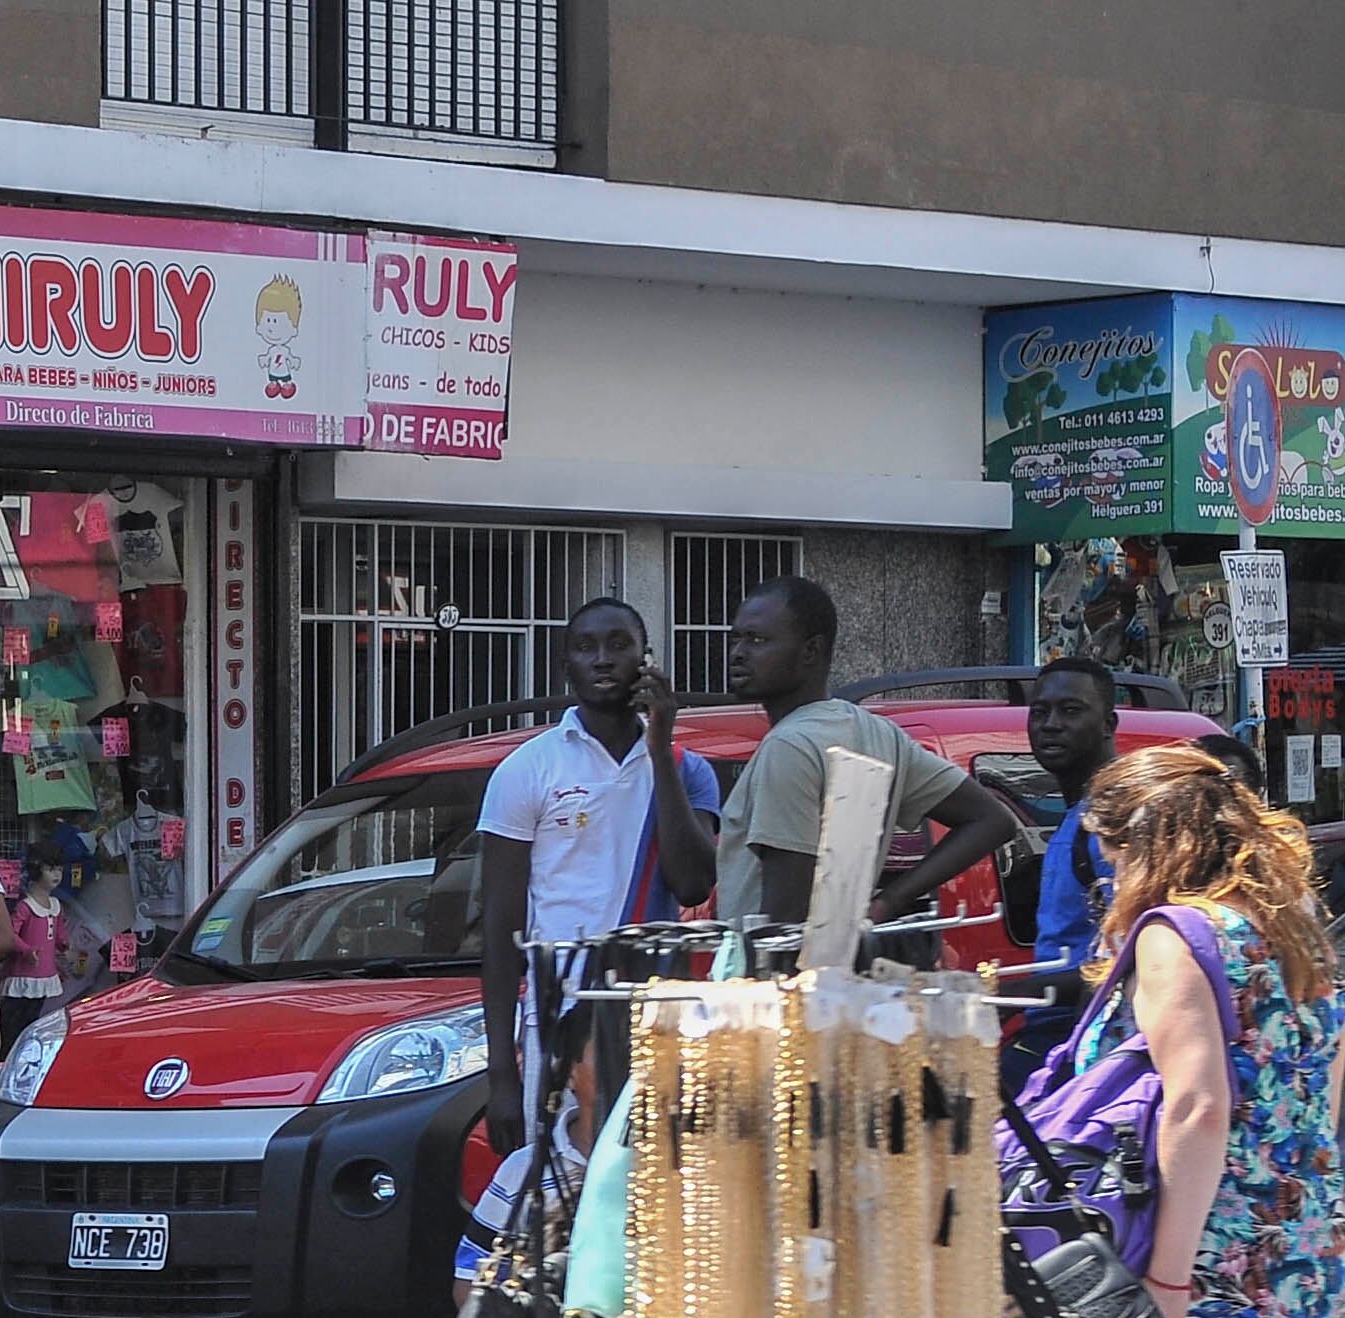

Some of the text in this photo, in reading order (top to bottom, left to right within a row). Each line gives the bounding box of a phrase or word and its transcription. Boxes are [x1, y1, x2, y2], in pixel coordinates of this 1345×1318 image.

[372, 253, 517, 323] RULY
[381, 326, 445, 349] CHICOS
[468, 332, 510, 354] KIDS
[999, 326, 1164, 381] Conejitos
[28, 366, 77, 387] BEBES
[93, 367, 137, 391] NIÑOS
[153, 375, 216, 396] JUNIORS
[366, 367, 409, 394] jeans
[436, 371, 456, 394] de
[464, 375, 501, 397] todo
[6, 401, 154, 429] Directo de Fabrica
[1059, 408, 1165, 430] Tel.: 011 4613 4293
[382, 414, 416, 443] DE
[1011, 432, 1165, 456] www.conejitosbebes.com.ar
[1025, 486, 1061, 501] ventas
[1064, 486, 1081, 503] por
[1084, 482, 1118, 500] mayor
[1130, 479, 1165, 493] menor
[1195, 476, 1225, 495] Ropa
[1301, 482, 1326, 499] para
[1091, 500, 1164, 520] Helguera 391
[1228, 558, 1282, 580] Reservado
[1212, 623, 1229, 641] 391
[152, 1069, 180, 1088] FIAT
[73, 1227, 164, 1259] NCE 738
